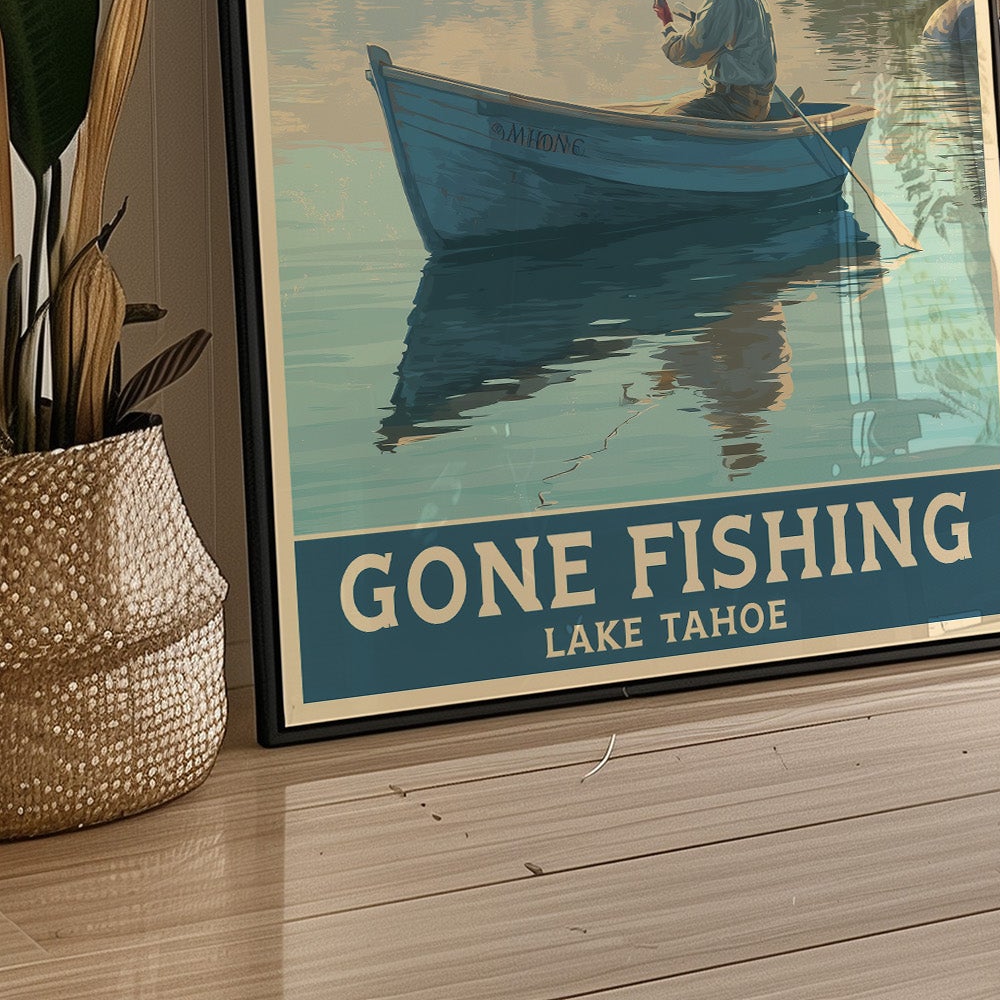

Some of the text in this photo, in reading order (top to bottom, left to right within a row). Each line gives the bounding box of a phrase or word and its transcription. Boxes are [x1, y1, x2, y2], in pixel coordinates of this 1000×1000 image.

[340, 492, 973, 633] GONE FISHING
[544, 599, 788, 659] LAKE TAHOE
